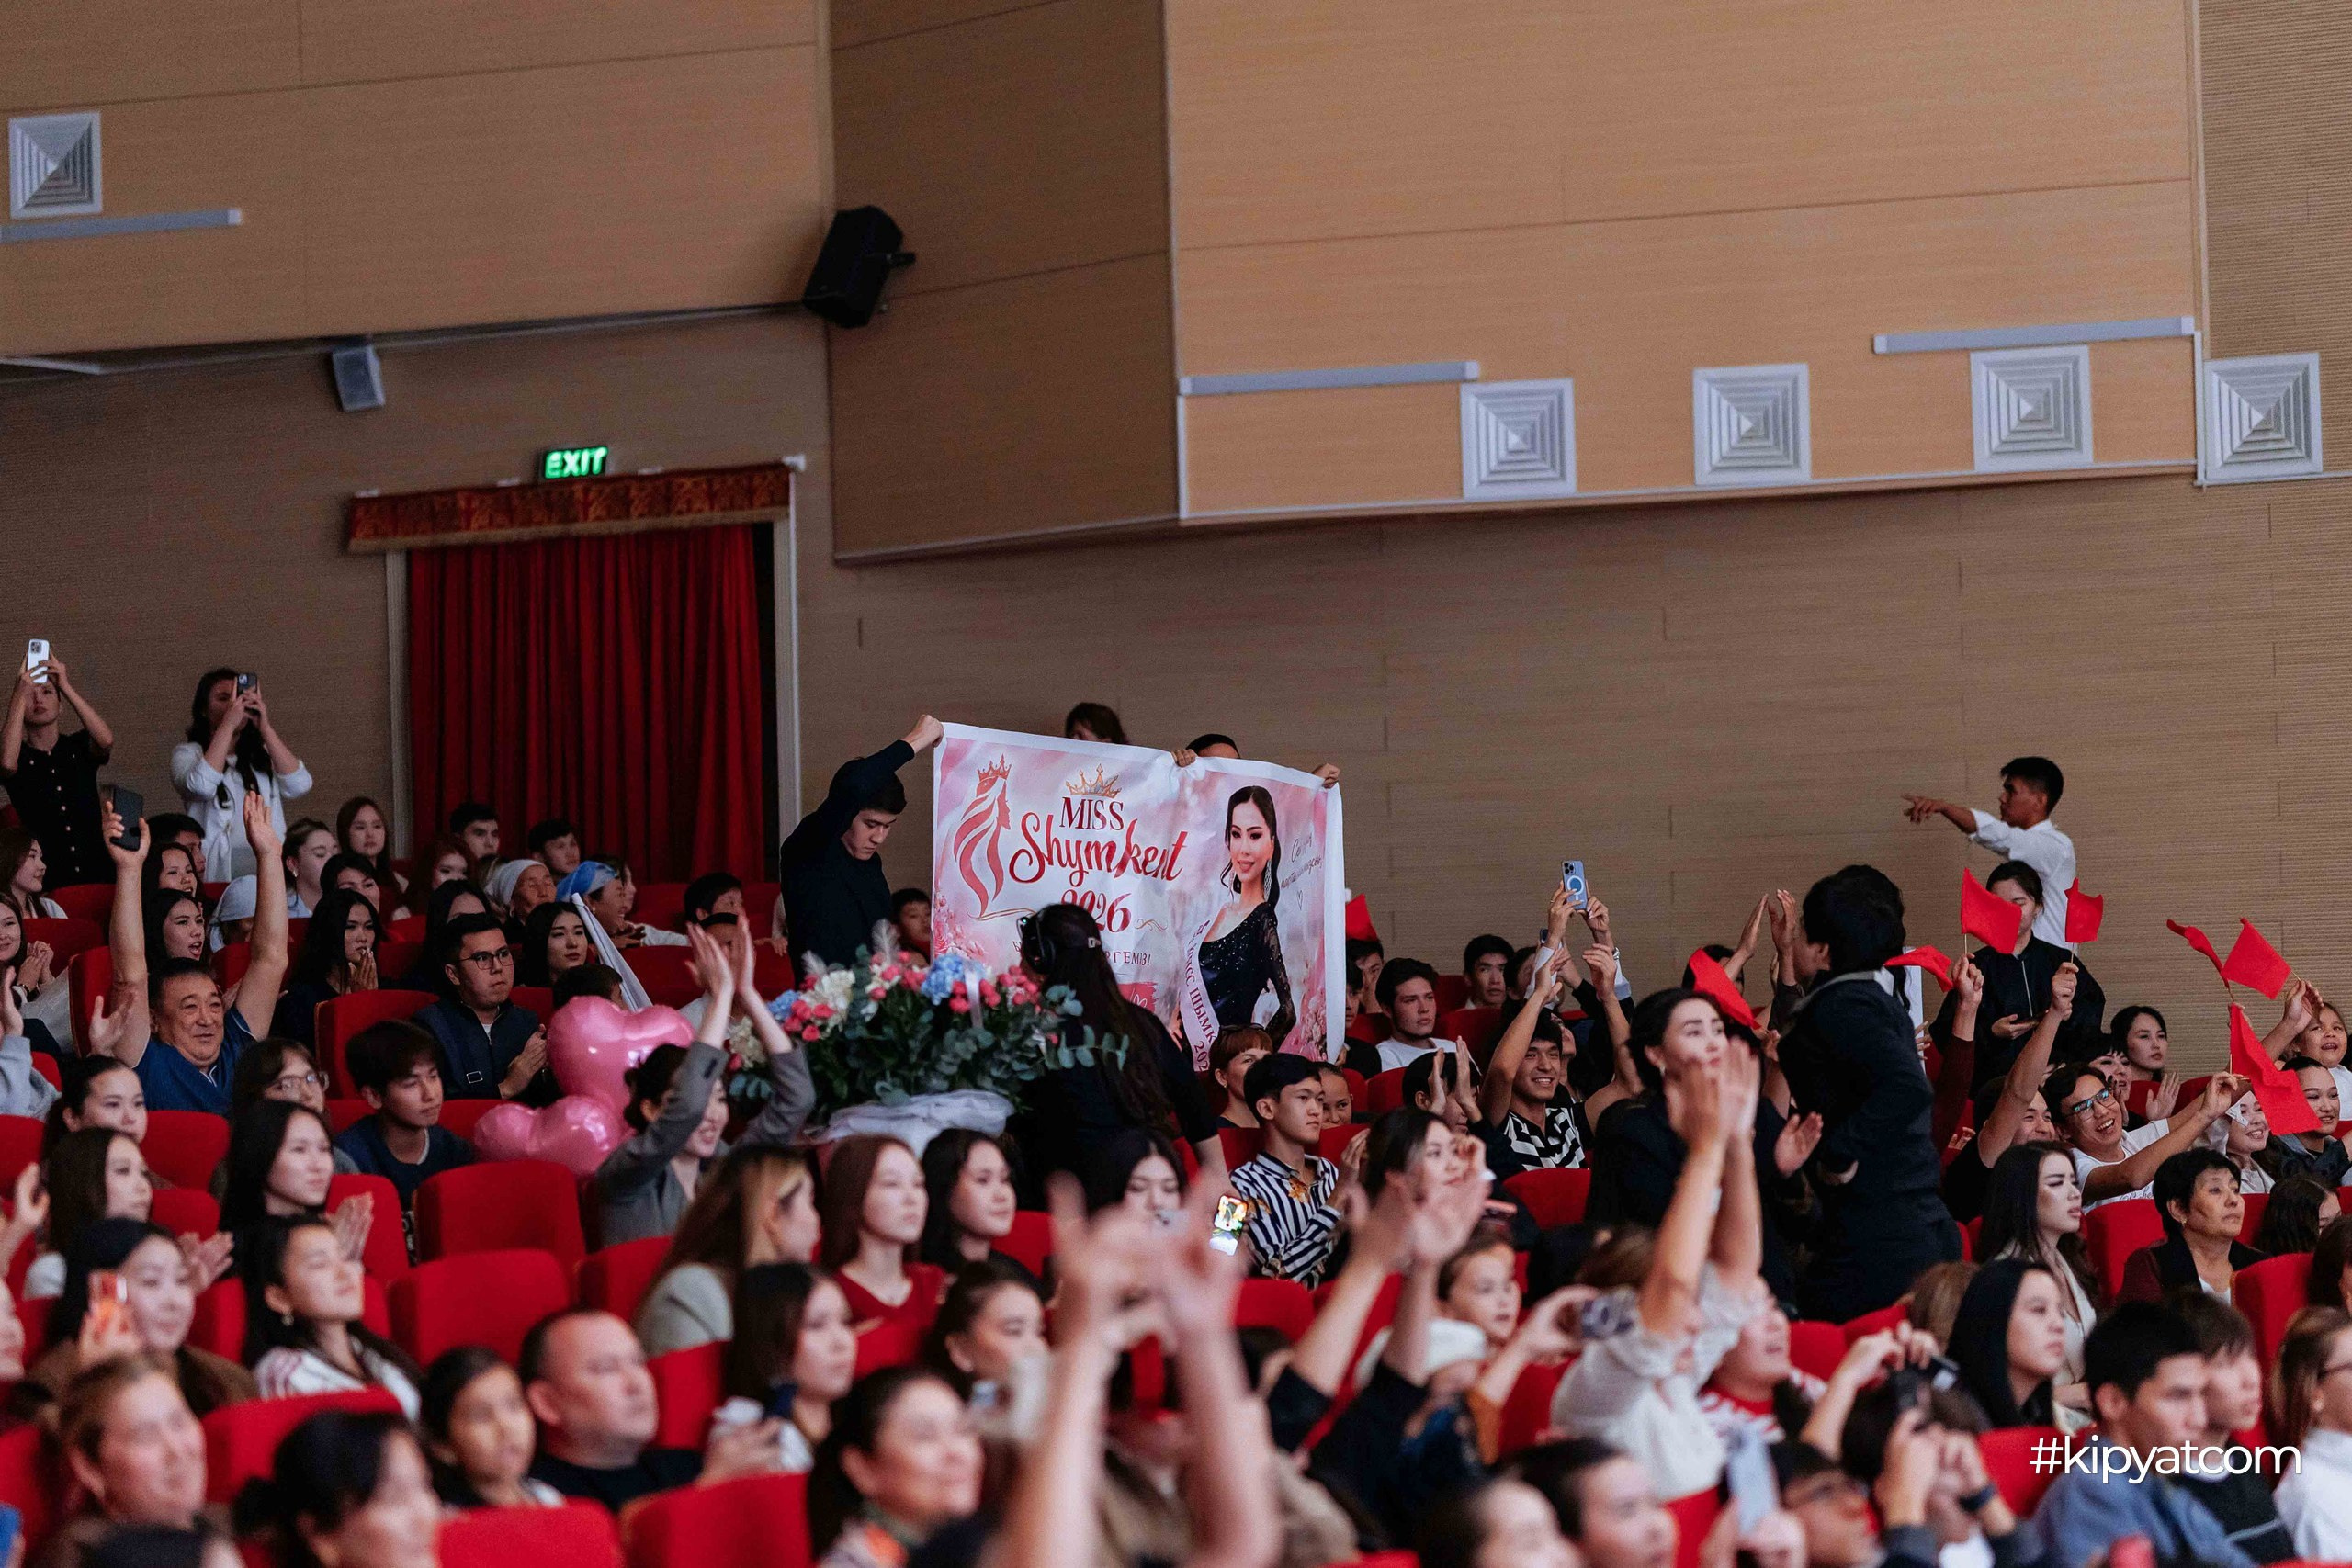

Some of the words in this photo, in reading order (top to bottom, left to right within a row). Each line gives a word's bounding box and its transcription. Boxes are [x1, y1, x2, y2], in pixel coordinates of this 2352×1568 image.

[545, 446, 608, 478] EXIT
[1059, 797, 1125, 831] MISS
[1009, 812, 1189, 887] Shymkent
